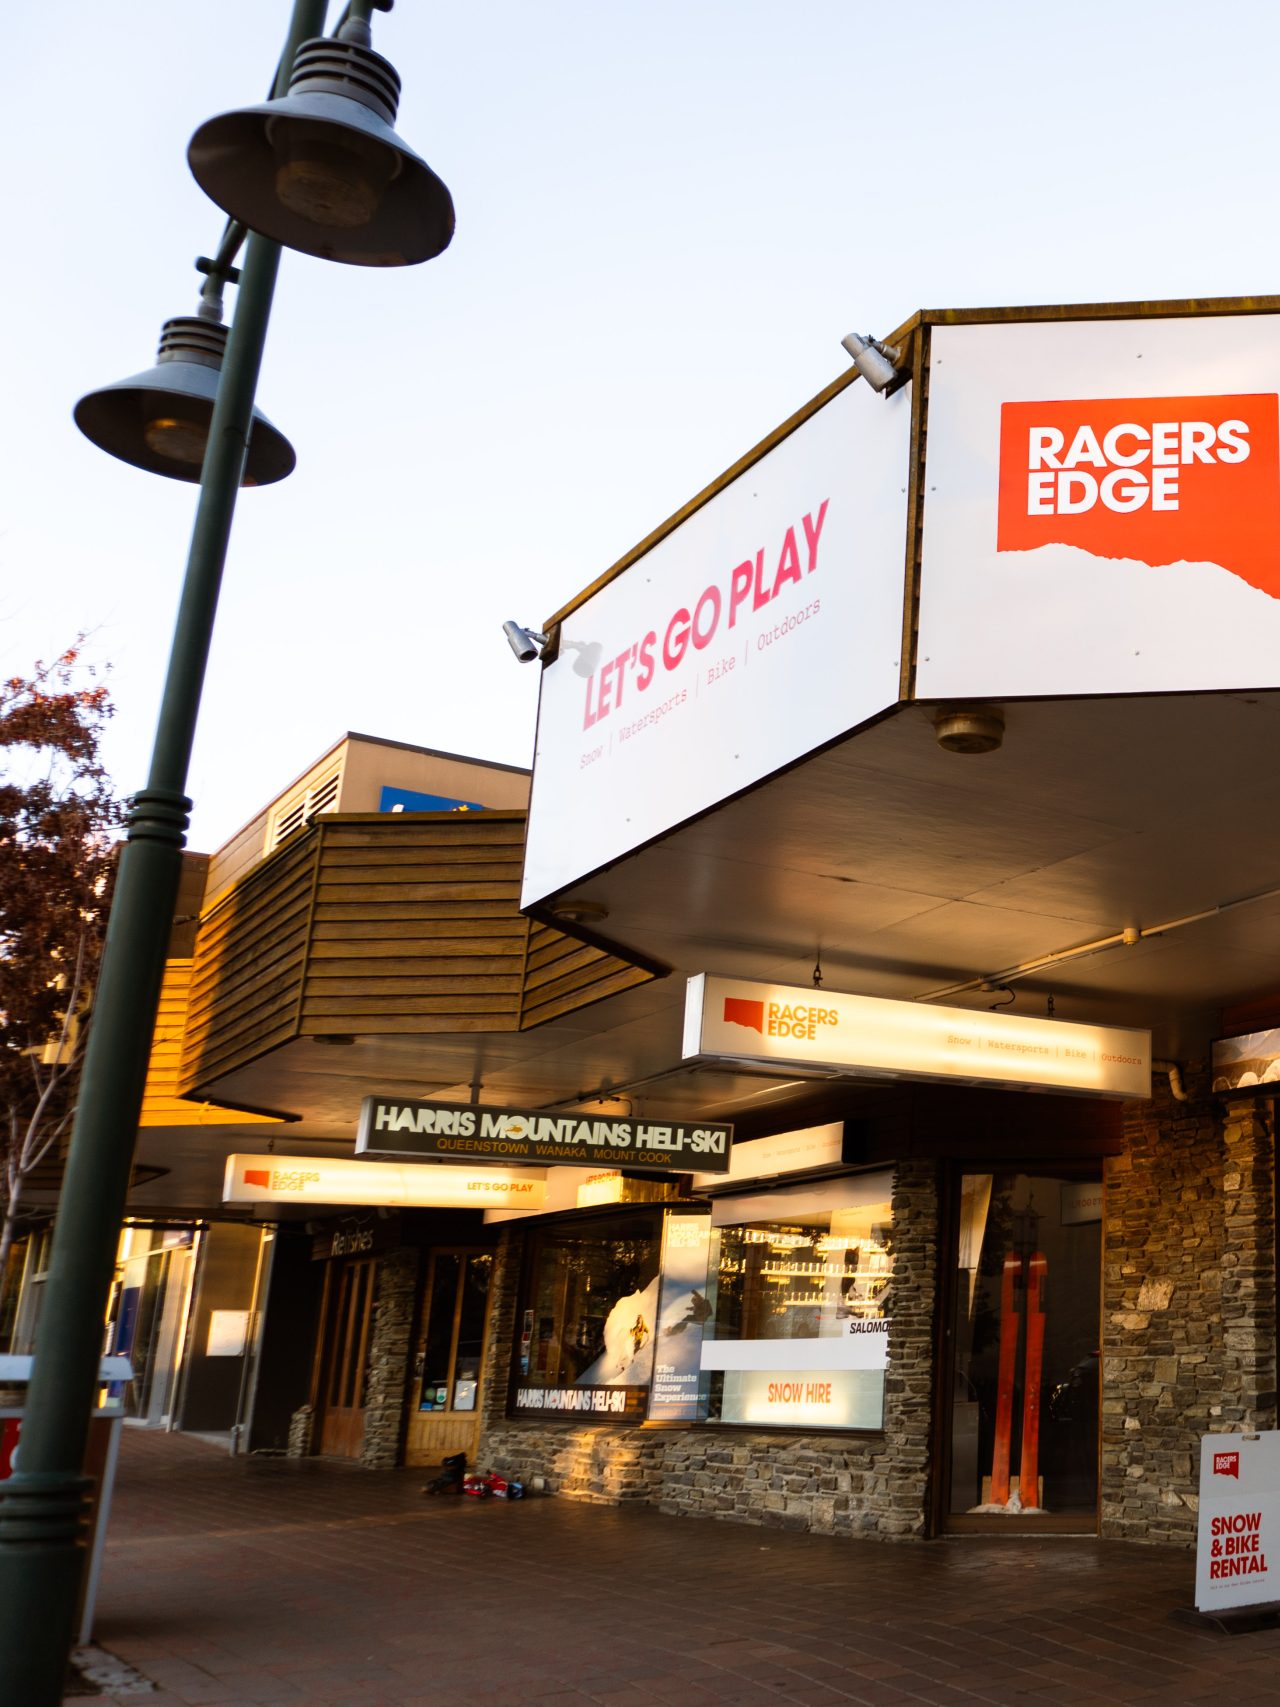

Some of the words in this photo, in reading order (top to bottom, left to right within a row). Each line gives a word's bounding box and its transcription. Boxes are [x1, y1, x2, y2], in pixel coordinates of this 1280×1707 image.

[1028, 419, 1251, 470] RACERS
[1027, 467, 1180, 516] EDGE
[582, 630, 657, 732] LET'S
[662, 585, 721, 671] GO
[728, 497, 830, 630] PLAY
[579, 744, 604, 770] Snow
[618, 688, 687, 743] Watersports
[706, 654, 736, 686] Bike
[756, 598, 821, 651] Outdoors
[768, 1002, 839, 1026] RACERS
[767, 1019, 817, 1041] EDGE
[947, 1034, 972, 1046] Snow
[987, 1039, 1049, 1056] Watersports
[1064, 1048, 1087, 1059] Bike
[1101, 1053, 1142, 1065] Outdoors
[374, 1104, 476, 1137] HARRIS
[480, 1113, 632, 1147] MOUNTAINS
[636, 1125, 726, 1154] HELI-SKI
[436, 1138, 529, 1155] QUEENSTOWN
[535, 1145, 588, 1158] WANAKA
[593, 1149, 639, 1161] MOUNT
[639, 1151, 672, 1164] COOK
[271, 1180, 305, 1191] EDGE
[272, 1170, 321, 1183] RACERS
[467, 1181, 491, 1191] LET'S
[492, 1183, 509, 1191] GO
[510, 1184, 534, 1193] PLAY
[849, 1320, 889, 1334] SALOMO
[655, 1373, 697, 1383] Ultimate
[656, 1364, 676, 1375] The
[653, 1392, 706, 1403] Experience
[654, 1384, 682, 1393] Snow
[768, 1382, 804, 1404] SNOW
[806, 1382, 832, 1404] HIRE
[516, 1388, 543, 1408] HARRIS
[543, 1388, 591, 1411] MOUNTAINS
[592, 1390, 626, 1413] HELI-SKI
[1215, 1455, 1237, 1464] RACERS
[1215, 1462, 1230, 1470] EDGE
[1211, 1512, 1262, 1536] SNOW
[1210, 1538, 1223, 1558] &
[1225, 1533, 1260, 1556] BIKE
[1210, 1554, 1268, 1579] RENTAL
